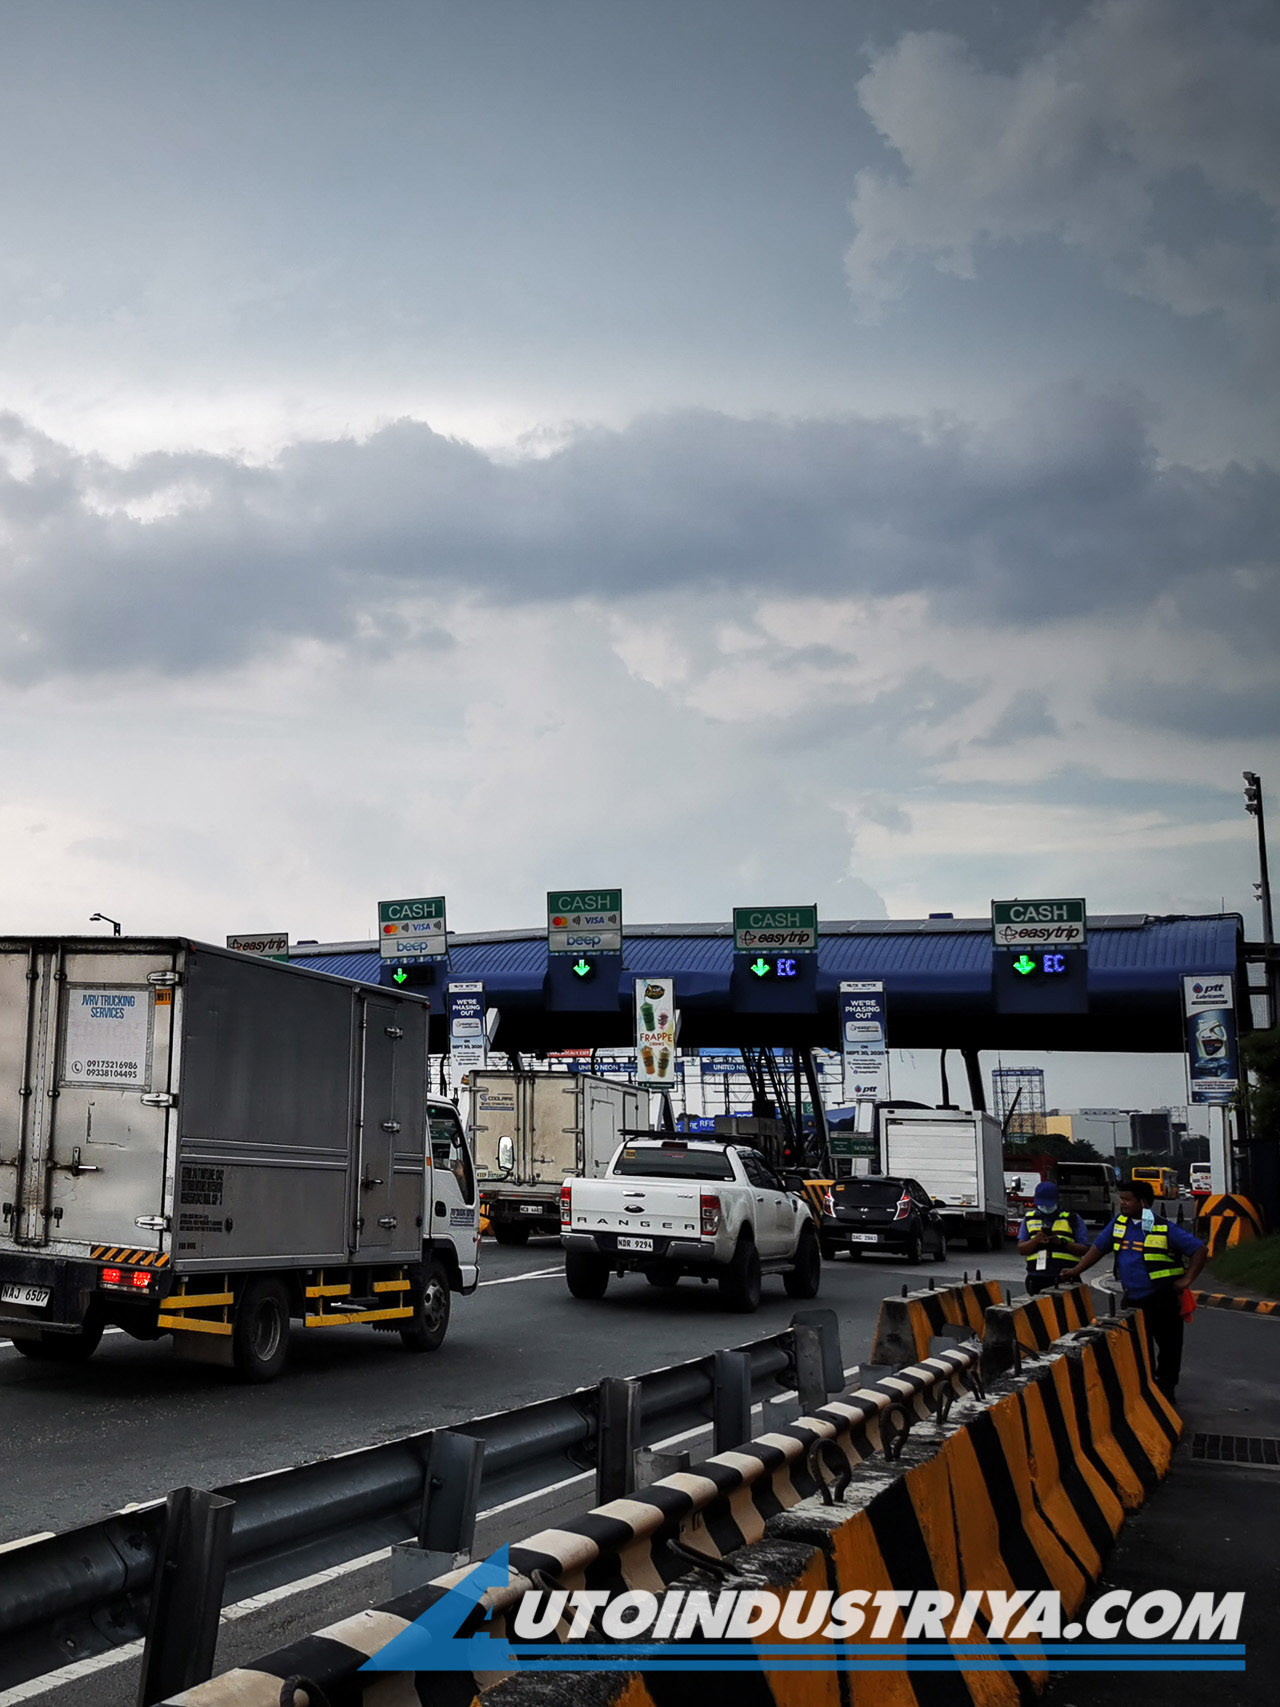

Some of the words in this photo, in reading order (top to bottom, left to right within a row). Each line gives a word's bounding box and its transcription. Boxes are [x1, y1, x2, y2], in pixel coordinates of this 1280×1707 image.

[559, 895, 610, 910] CASH
[389, 904, 435, 918] CASH
[1010, 905, 1067, 921] CASH
[585, 916, 605, 924] VISA
[750, 913, 800, 928] CASH
[412, 923, 431, 931] VISA
[1018, 925, 1080, 941] easytrip
[567, 934, 601, 948] beep
[758, 930, 810, 945] easytrip
[243, 938, 286, 952] easytrip
[397, 941, 428, 953] beep
[777, 958, 796, 976] EC
[1043, 954, 1065, 972] EC
[1204, 984, 1224, 994] ptt
[81, 994, 100, 1006] JVRV
[100, 995, 136, 1007] TRUCKING
[90, 1007, 125, 1019] SERVICES
[640, 1033, 672, 1042] FRAPPE
[86, 1060, 138, 1070] 09175216986
[86, 1068, 138, 1078] 09338104495
[862, 1086, 878, 1094] ptt
[576, 1217, 695, 1230] RANGER
[2, 1286, 21, 1300] NAJ
[25, 1289, 49, 1302] 6507
